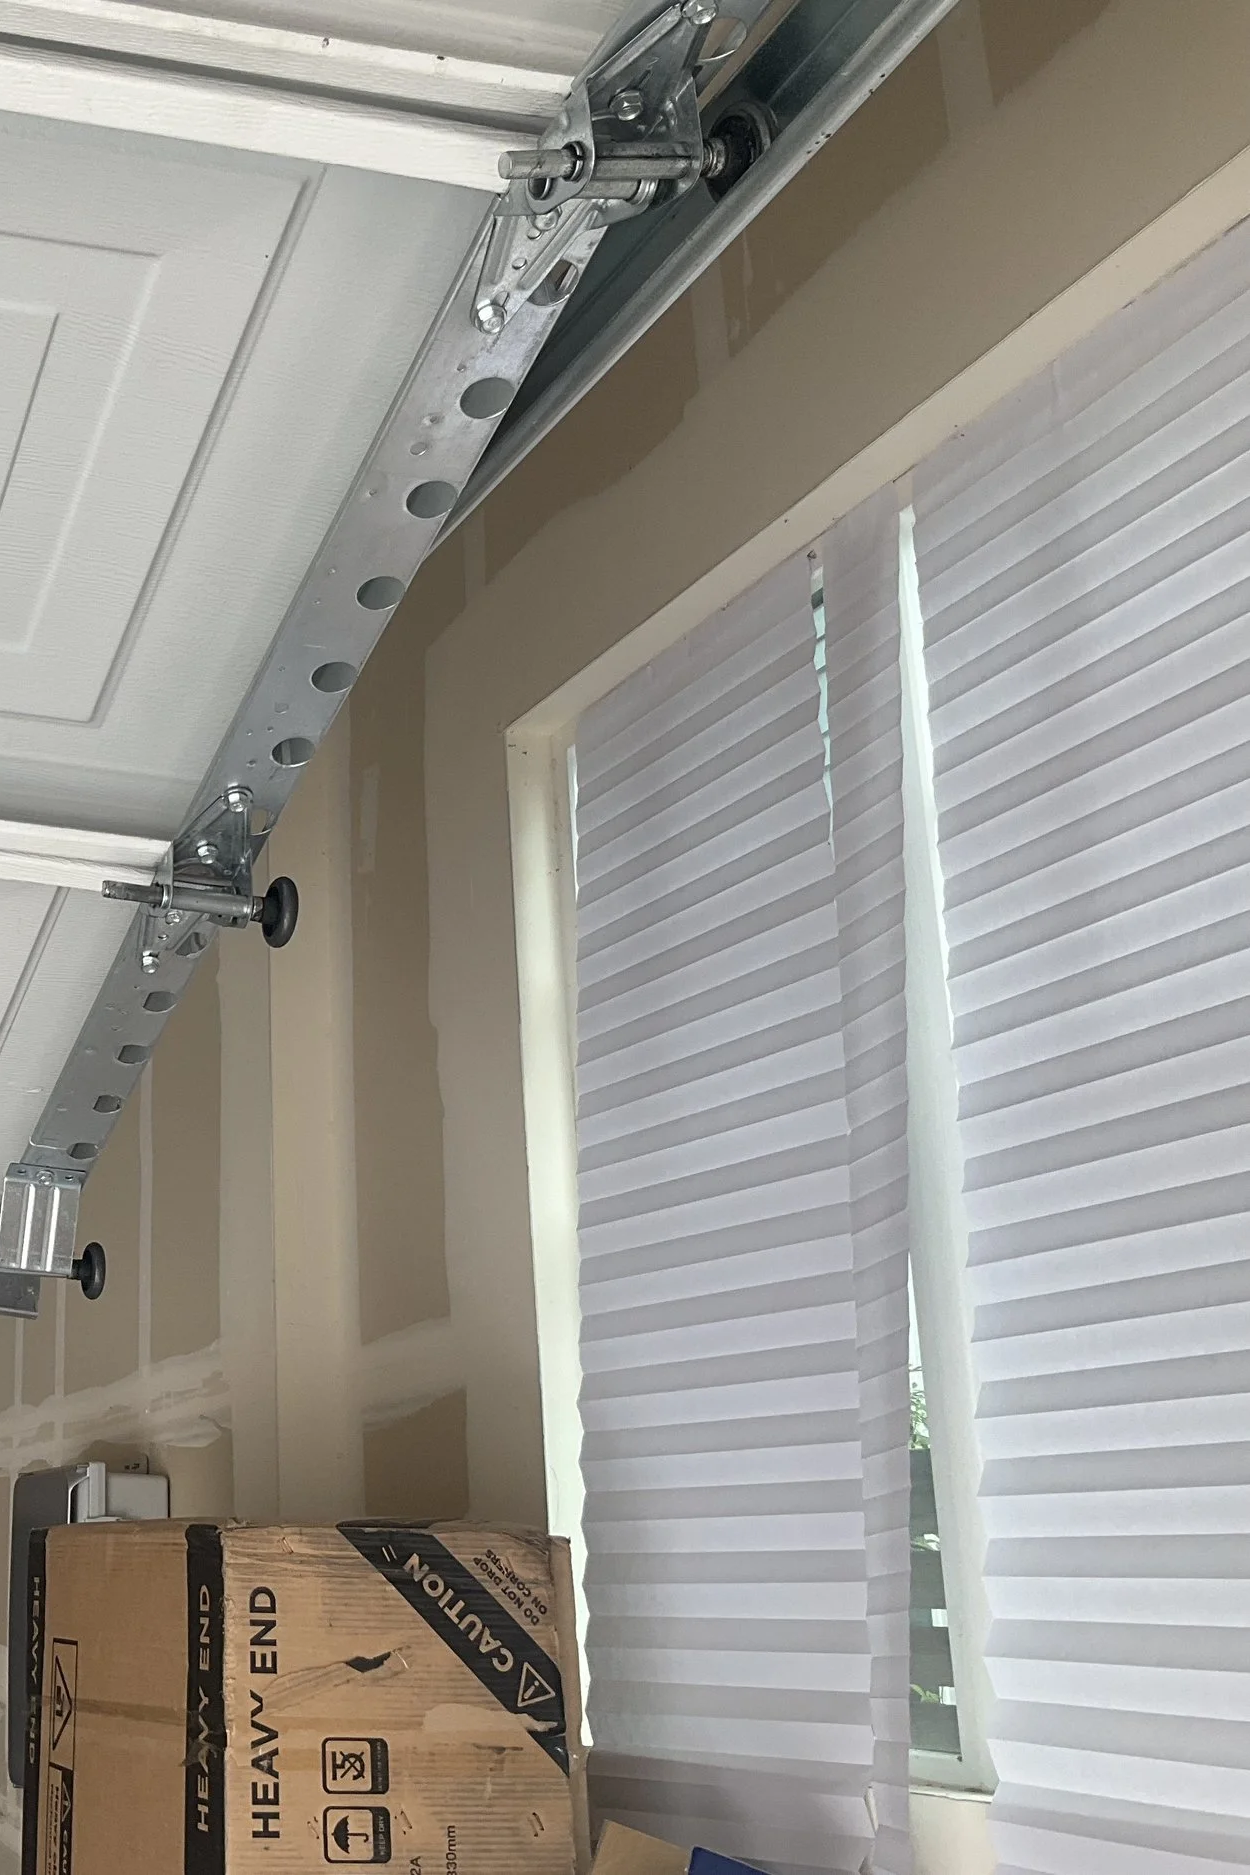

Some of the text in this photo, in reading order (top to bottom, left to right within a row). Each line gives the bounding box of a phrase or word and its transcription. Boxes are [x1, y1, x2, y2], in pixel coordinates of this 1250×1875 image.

[402, 1552, 514, 1673] CAUTION
[472, 1556, 540, 1626] DO NOT DROP
[484, 1548, 548, 1616] ON CORNERS
[29, 1576, 41, 1764] HEAVY END
[197, 1584, 211, 1833] HEAVY END
[249, 1586, 281, 1839] HEAVY END
